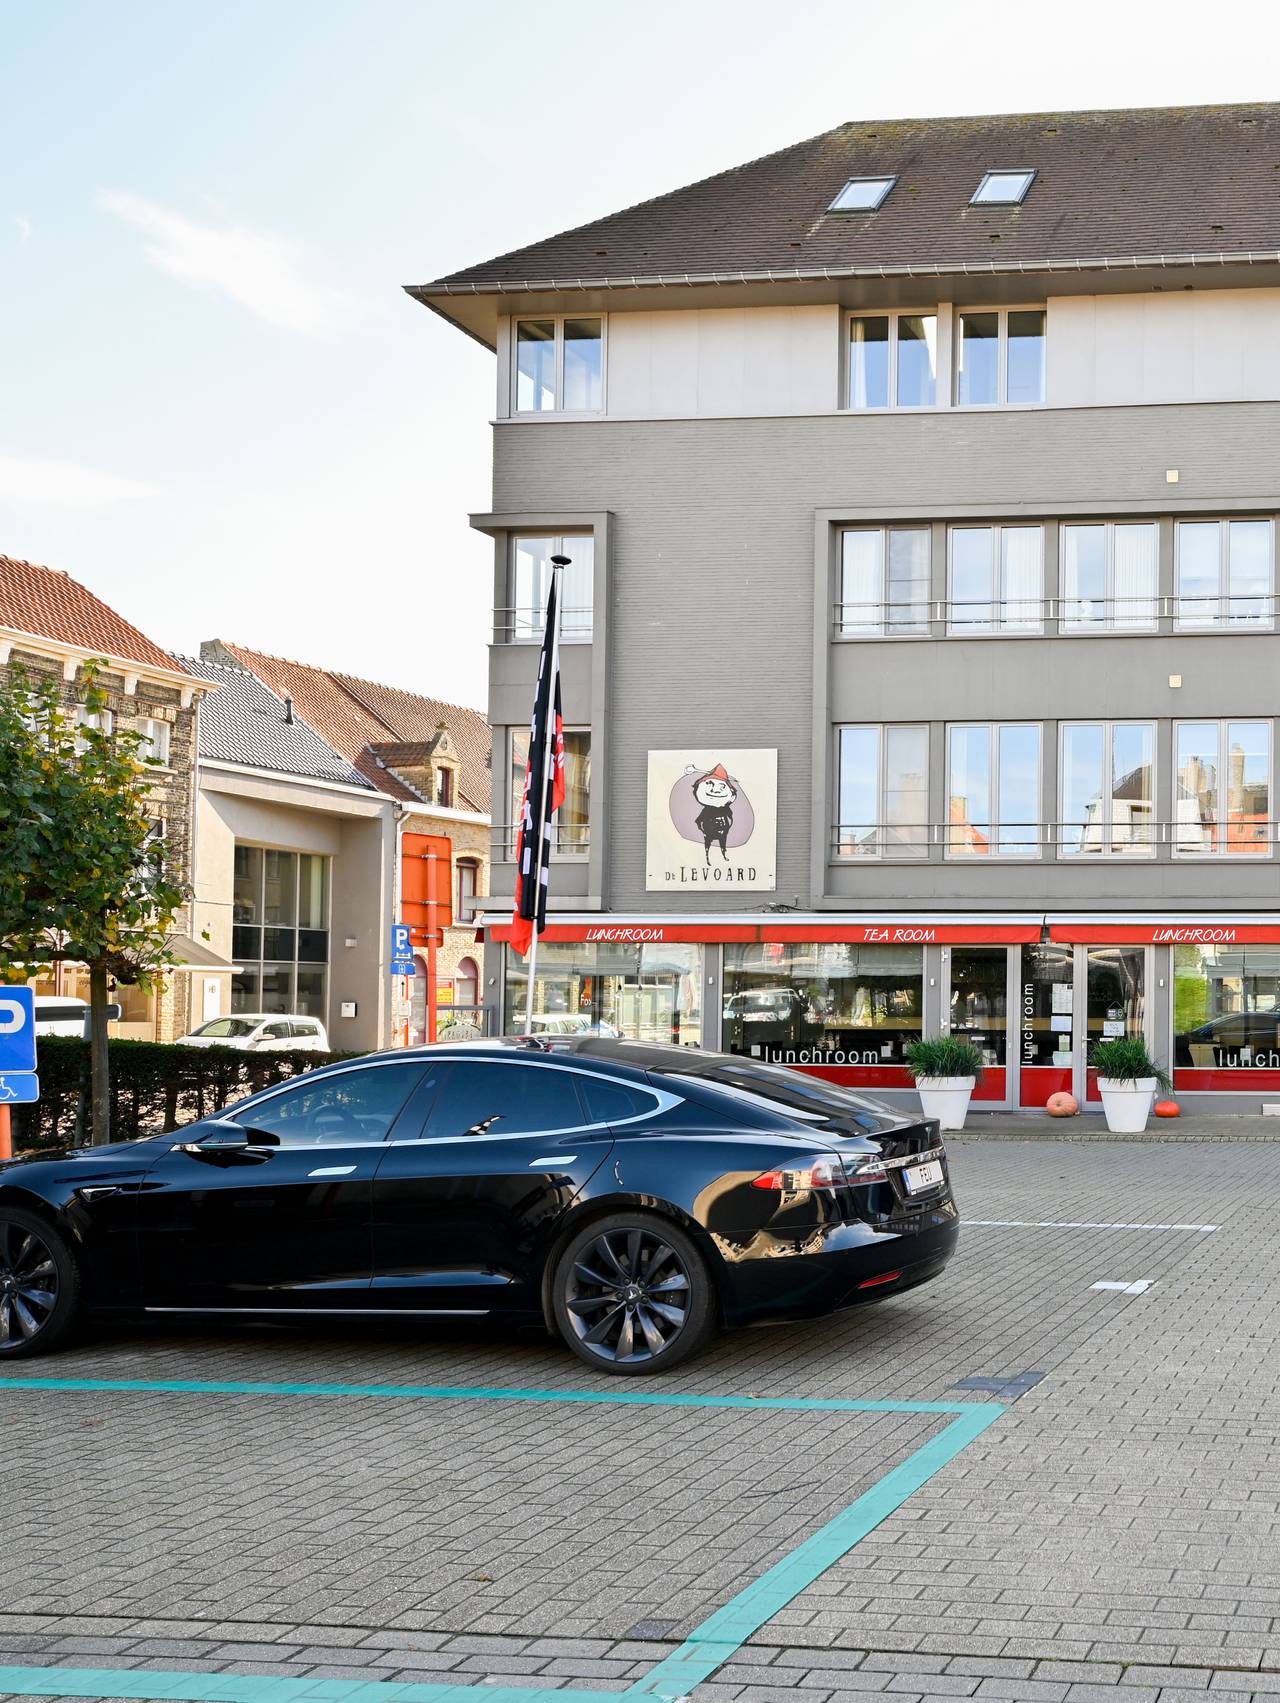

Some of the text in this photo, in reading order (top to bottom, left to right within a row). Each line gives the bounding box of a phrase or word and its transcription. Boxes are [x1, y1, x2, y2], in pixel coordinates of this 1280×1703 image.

[680, 866, 757, 882] LEVOARD
[585, 928, 665, 942] LUNCHROOM
[863, 928, 936, 942] TEA ROOM
[1152, 928, 1236, 942] LUNCHROOM
[1021, 983, 1034, 1065] lunchroom
[765, 1045, 879, 1064] lunchroom
